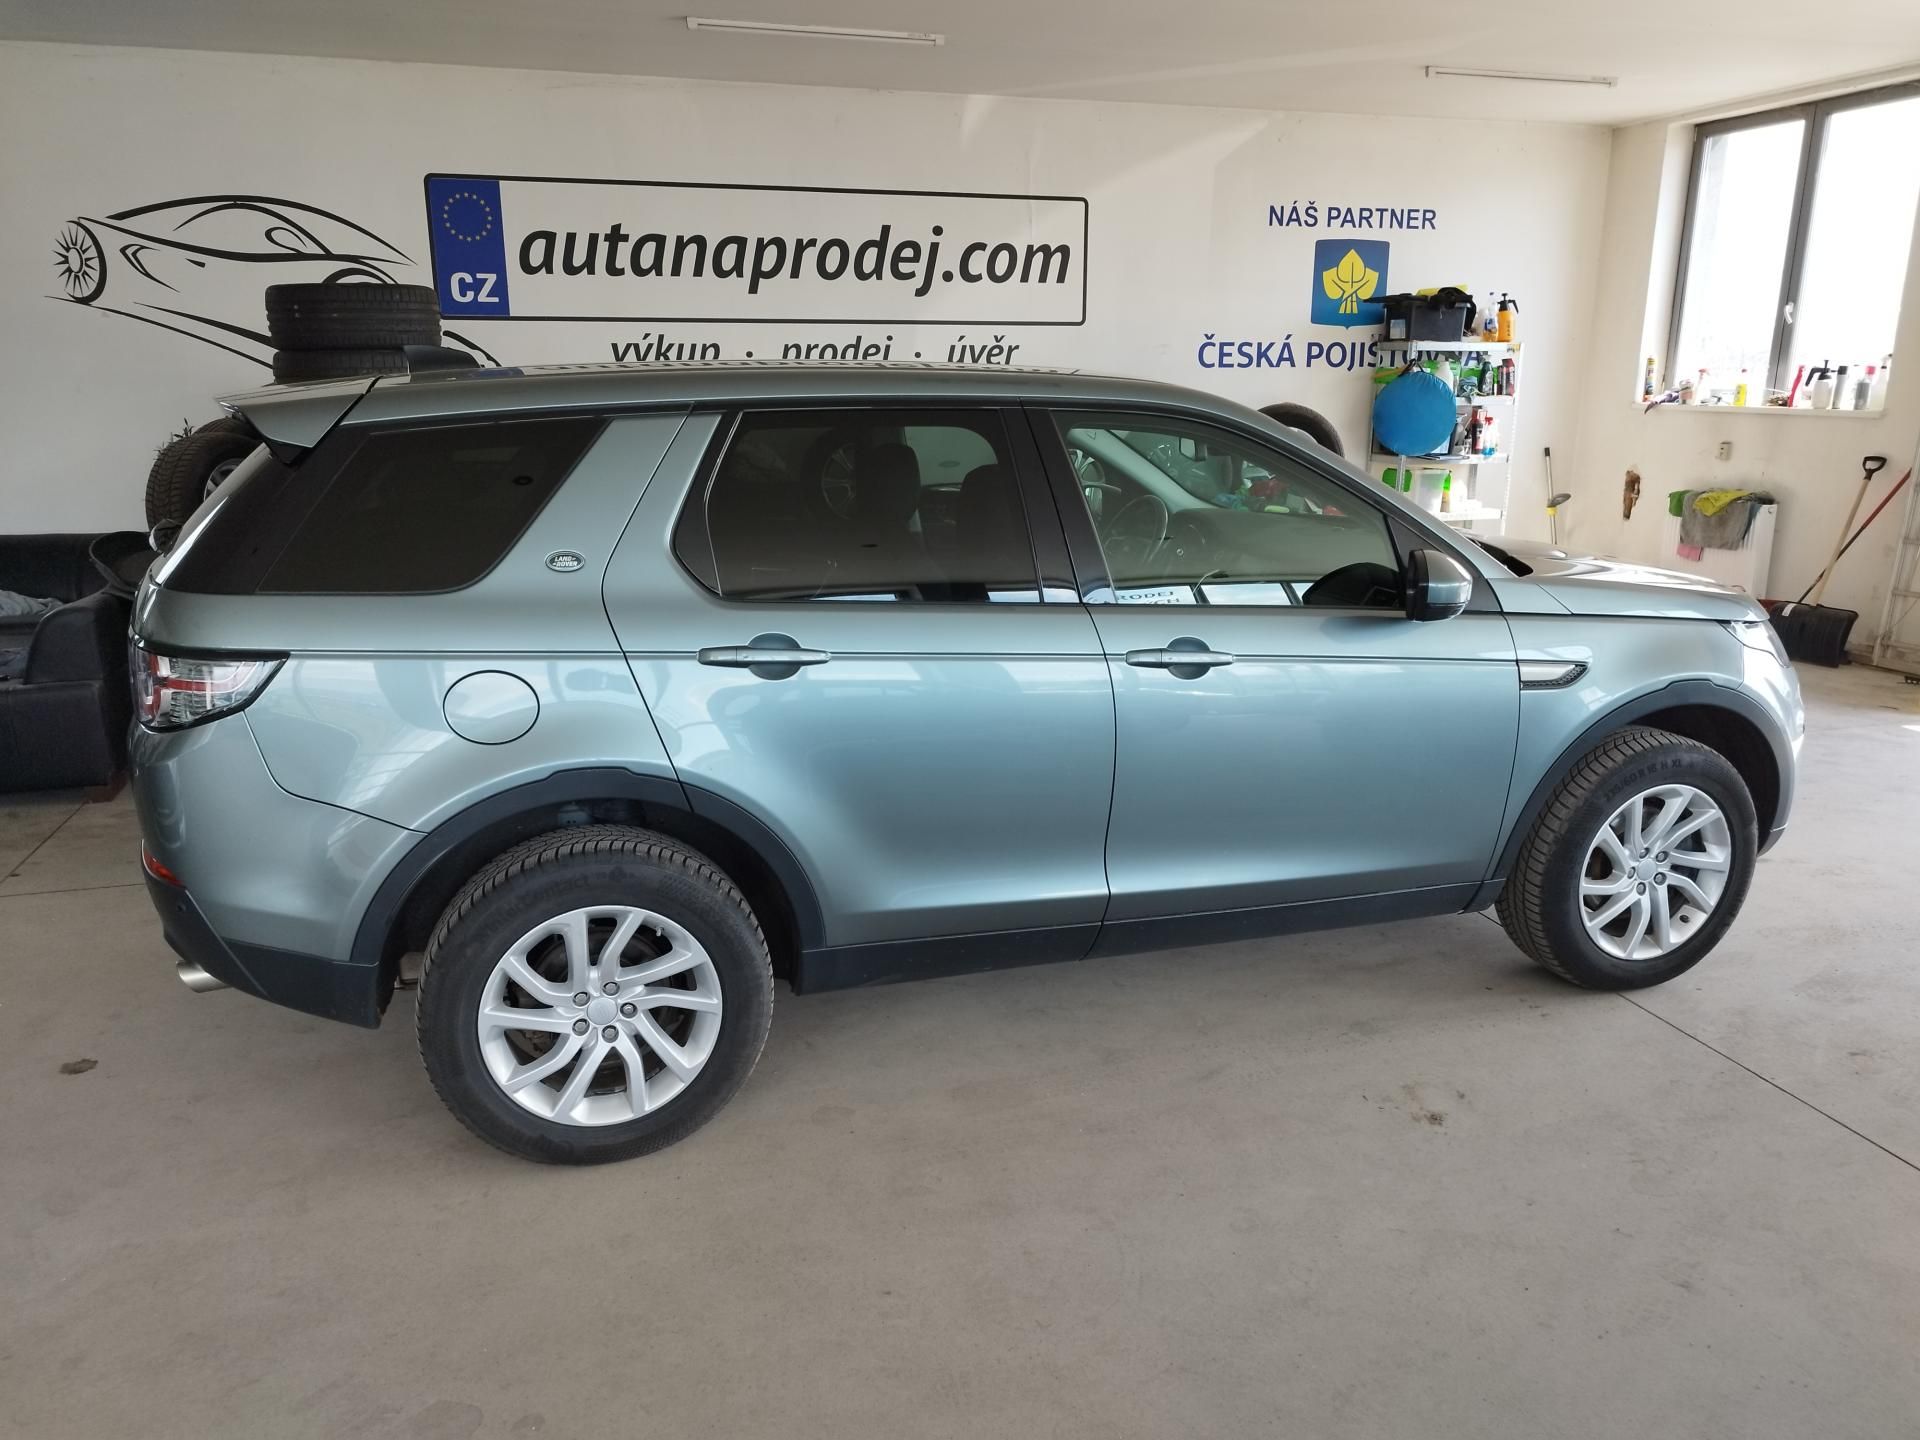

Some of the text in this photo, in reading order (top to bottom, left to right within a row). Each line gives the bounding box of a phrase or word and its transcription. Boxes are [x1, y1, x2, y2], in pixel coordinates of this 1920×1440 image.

[1268, 200, 1437, 230] NÁŠ PARTNER
[518, 222, 1071, 298] autanaprodej.com
[450, 272, 500, 304] CZ
[947, 335, 1020, 365] úvěr
[1197, 333, 1296, 369] ČESKÁ
